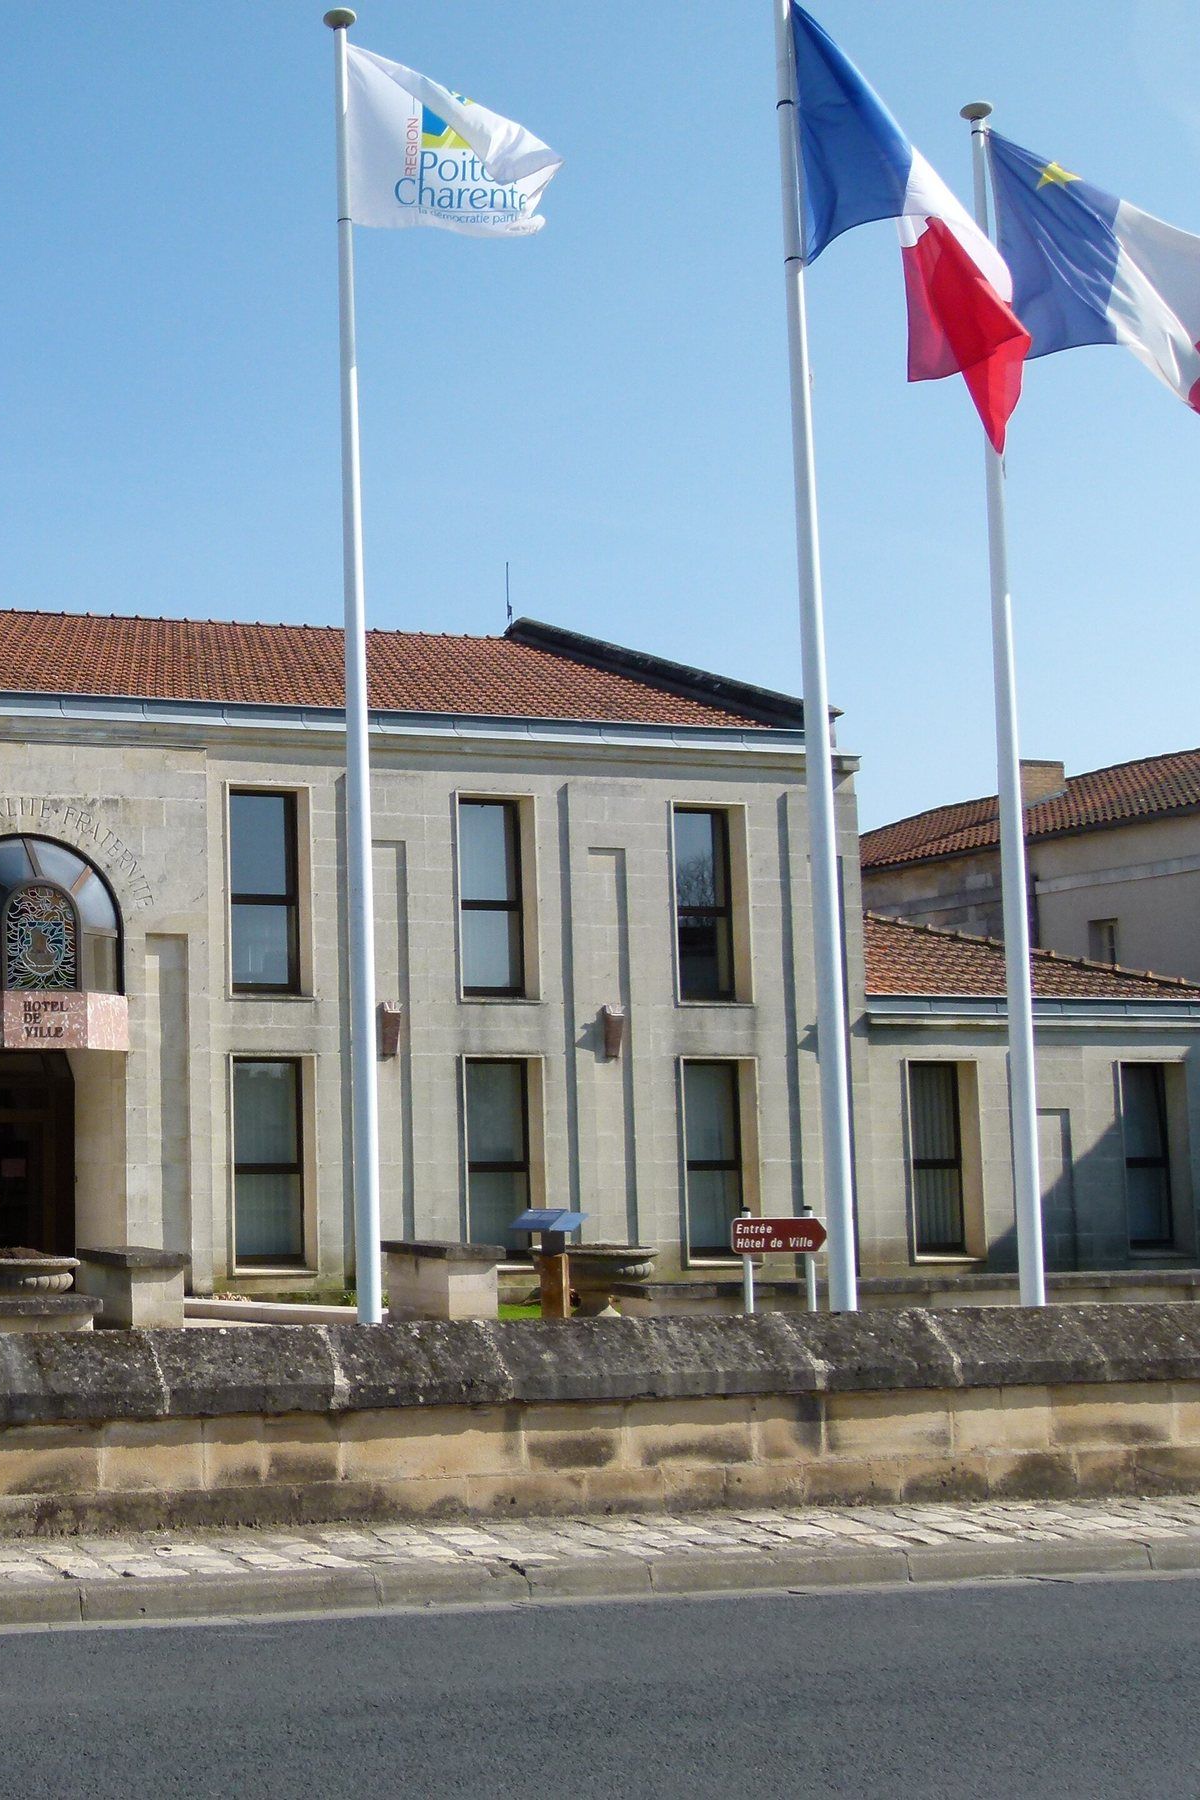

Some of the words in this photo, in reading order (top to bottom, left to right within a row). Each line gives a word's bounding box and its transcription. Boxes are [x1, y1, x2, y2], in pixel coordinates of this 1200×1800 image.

[404, 117, 419, 177] REGION
[63, 806, 156, 909] FRATERNITE
[24, 1001, 68, 1012] HOTEL
[24, 1013, 41, 1024] DE
[25, 1026, 63, 1037] VILLE
[736, 1223, 772, 1233] Entrée
[737, 1238, 765, 1248] Hôtel
[770, 1238, 783, 1248] de
[789, 1237, 813, 1247] Ville
